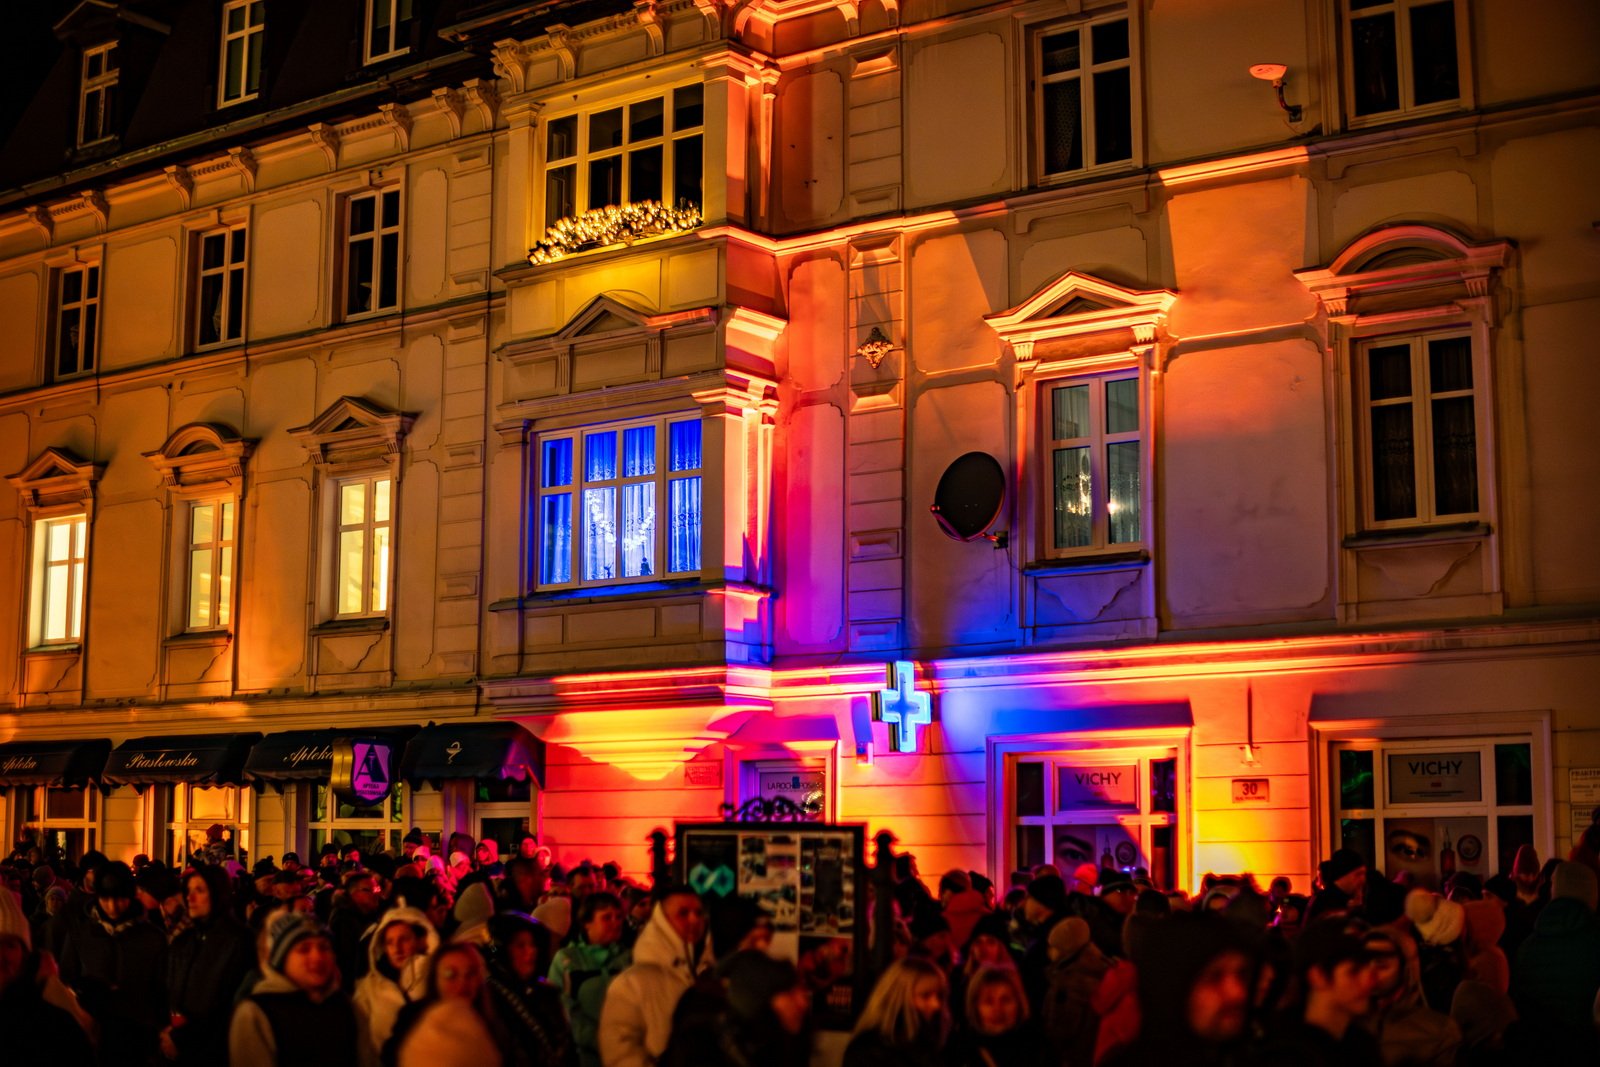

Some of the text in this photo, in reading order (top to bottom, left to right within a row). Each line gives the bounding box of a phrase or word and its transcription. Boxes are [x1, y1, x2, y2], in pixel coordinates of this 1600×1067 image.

[125, 752, 199, 769] Piastowska
[1408, 760, 1463, 776] VICHY
[1074, 772, 1122, 786] VICHY
[1241, 782, 1258, 796] 30
